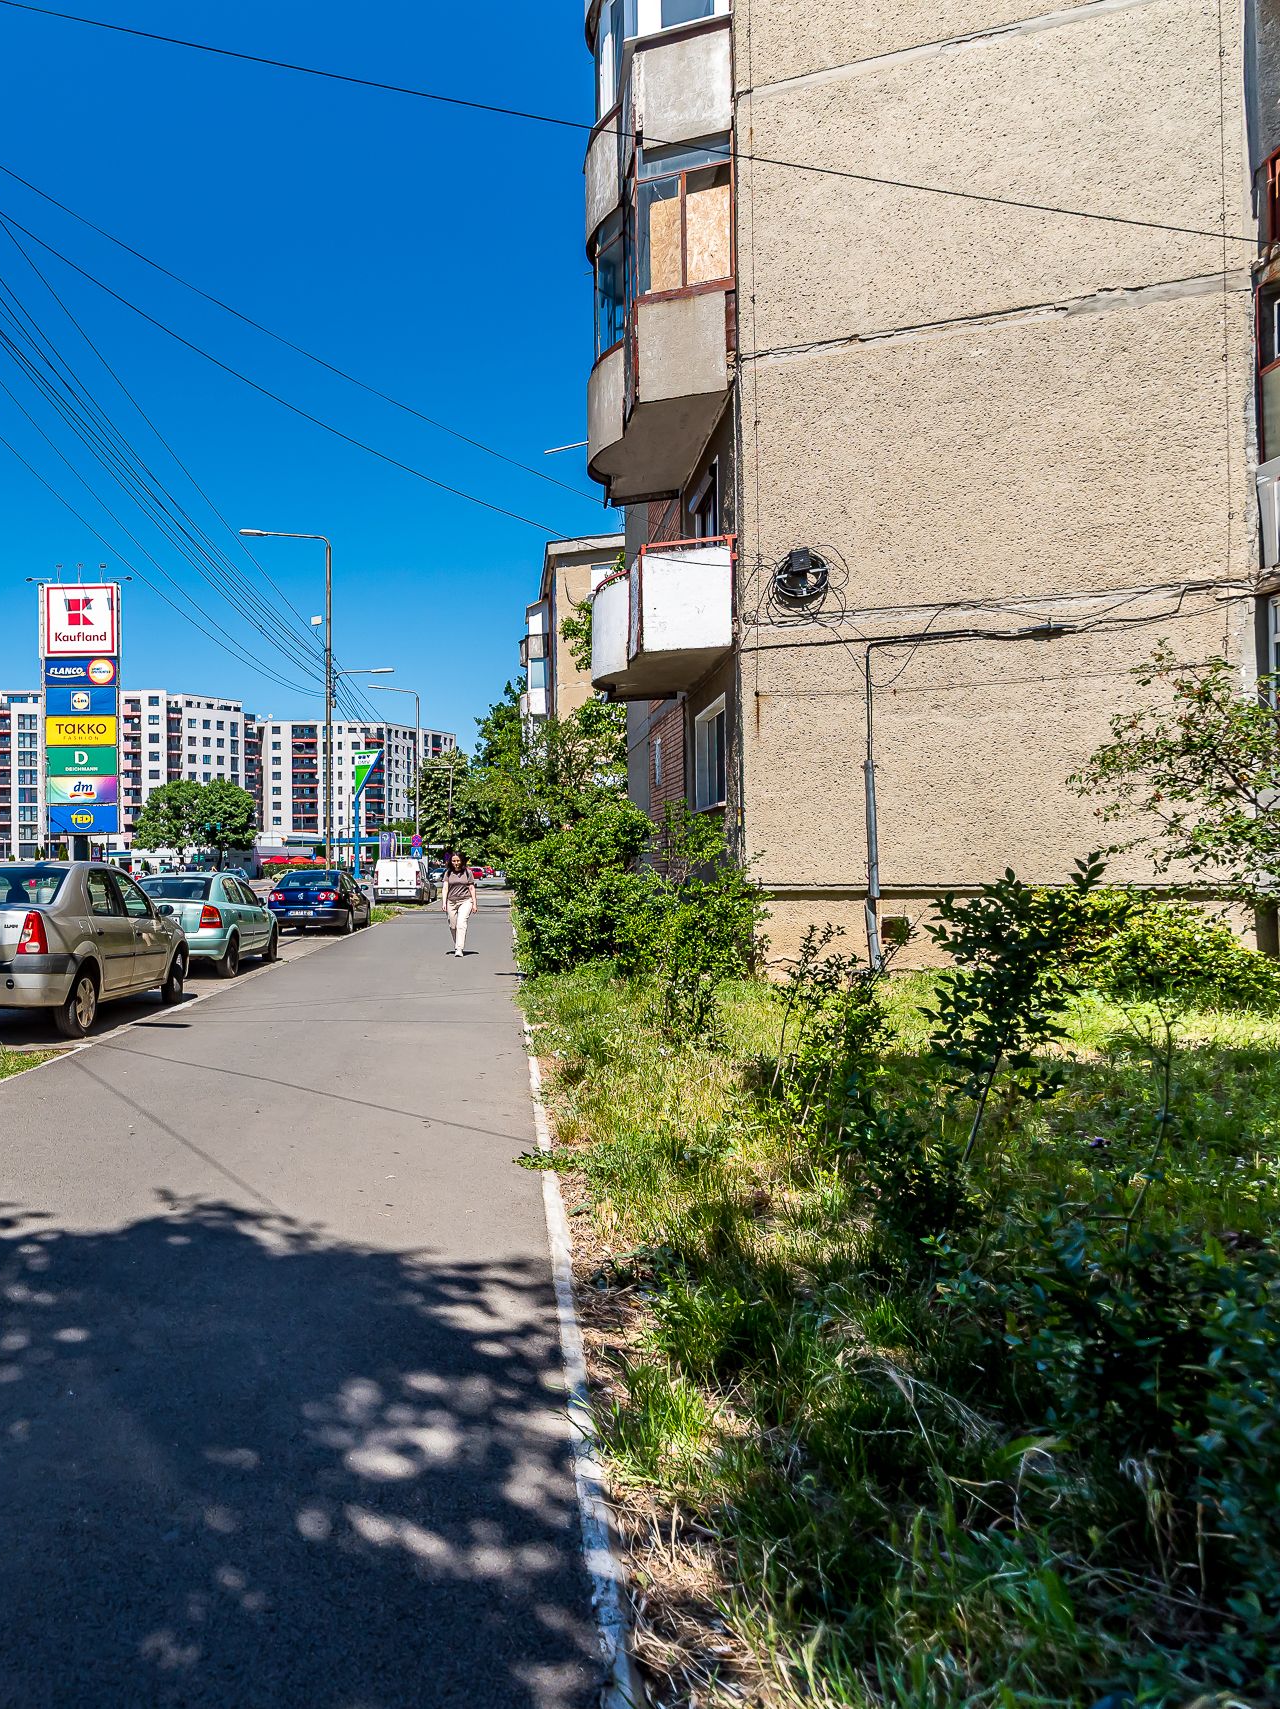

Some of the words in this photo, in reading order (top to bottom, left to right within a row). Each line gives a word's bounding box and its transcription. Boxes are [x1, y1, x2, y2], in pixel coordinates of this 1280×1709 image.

[55, 631, 107, 642] Kaufland
[49, 667, 84, 675] FLANCO
[74, 750, 89, 765] D
[73, 781, 93, 792] dm
